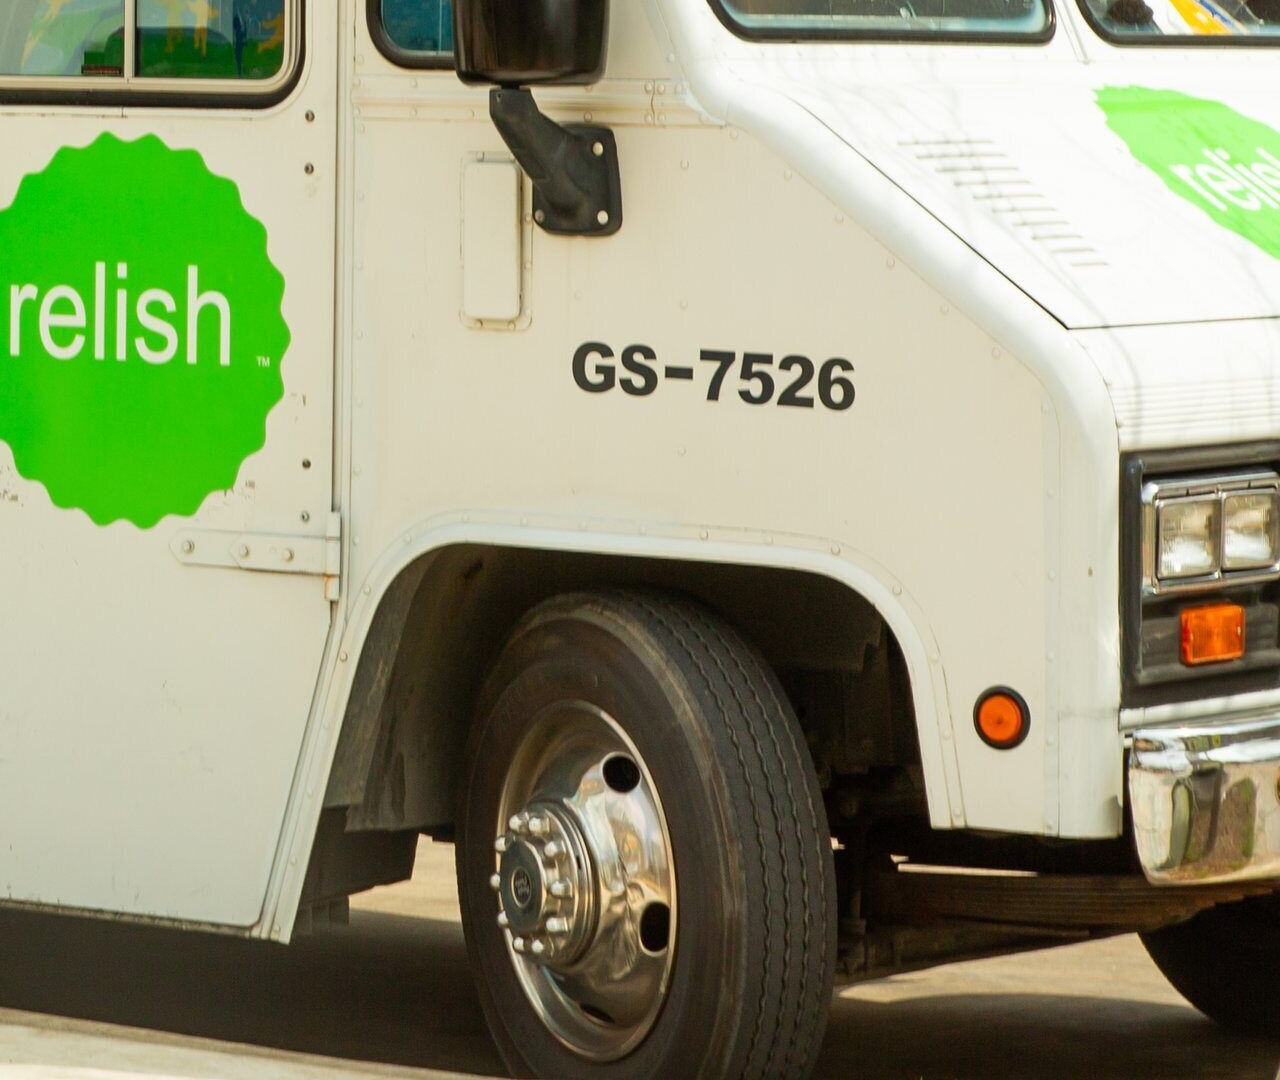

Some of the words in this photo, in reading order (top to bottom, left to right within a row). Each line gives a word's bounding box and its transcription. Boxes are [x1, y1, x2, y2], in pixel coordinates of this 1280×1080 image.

[9, 261, 231, 366] relish
[256, 356, 270, 367] TM
[571, 341, 856, 411] GS-7526
